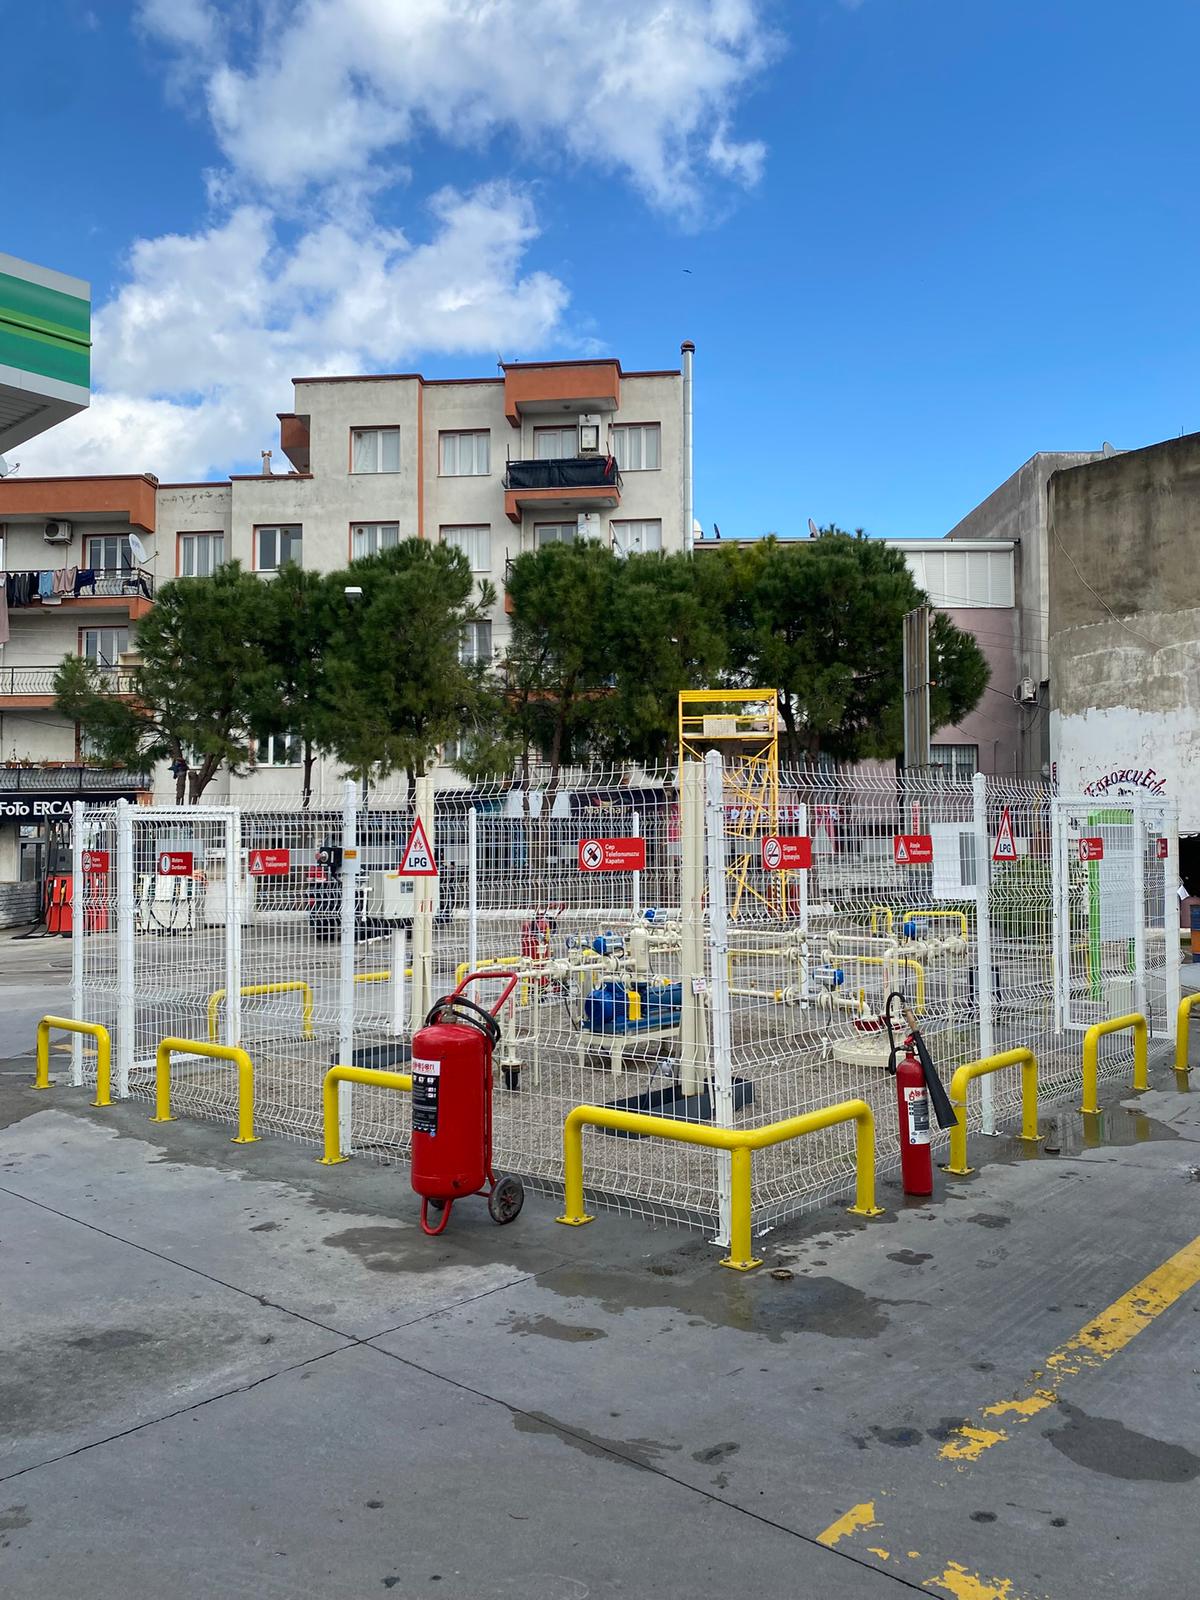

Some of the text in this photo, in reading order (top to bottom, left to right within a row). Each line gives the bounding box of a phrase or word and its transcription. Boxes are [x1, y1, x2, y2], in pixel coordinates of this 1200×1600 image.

[33, 801, 73, 816] ERCA
[999, 843, 1012, 853] LPG
[408, 857, 428, 868] LPG
